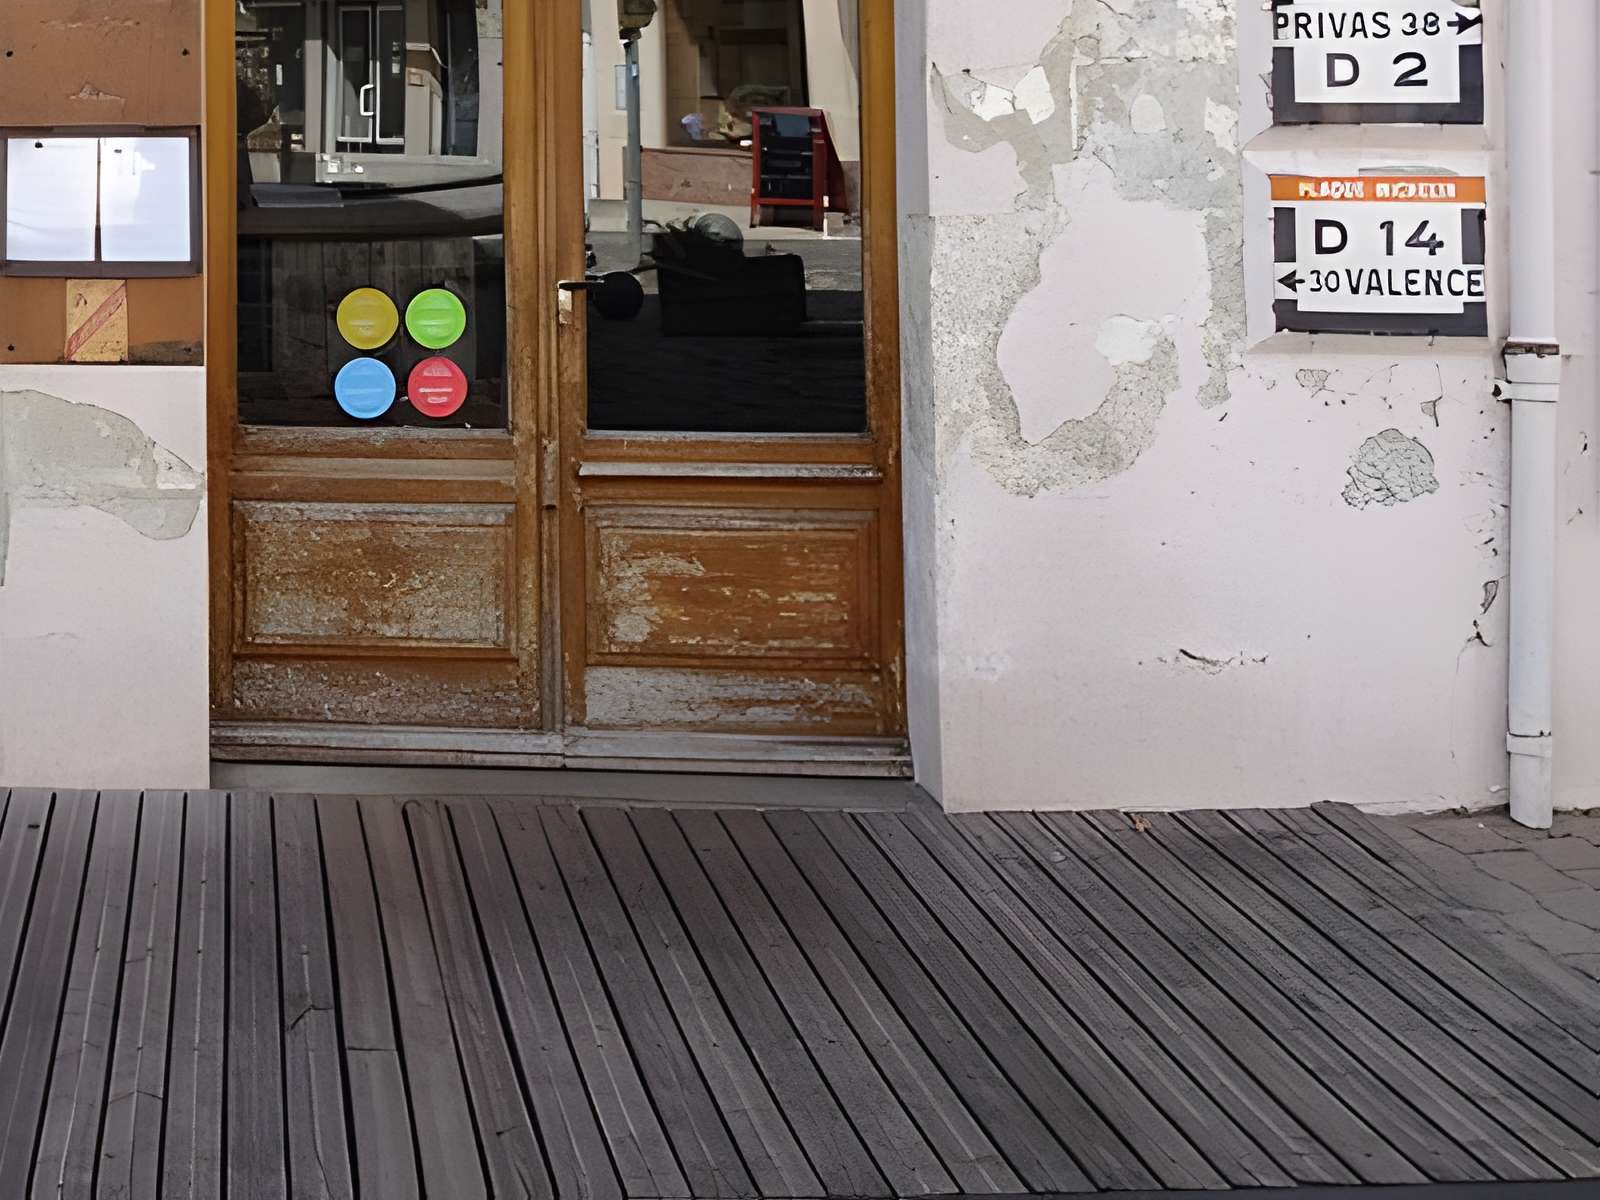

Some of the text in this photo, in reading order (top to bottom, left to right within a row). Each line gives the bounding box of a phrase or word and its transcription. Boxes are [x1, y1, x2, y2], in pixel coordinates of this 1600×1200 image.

[1274, 11, 1390, 39] PRIVAS
[1326, 51, 1428, 87] D 2
[1314, 219, 1444, 256] D 14
[1309, 268, 1485, 296] 30 VALENCE
